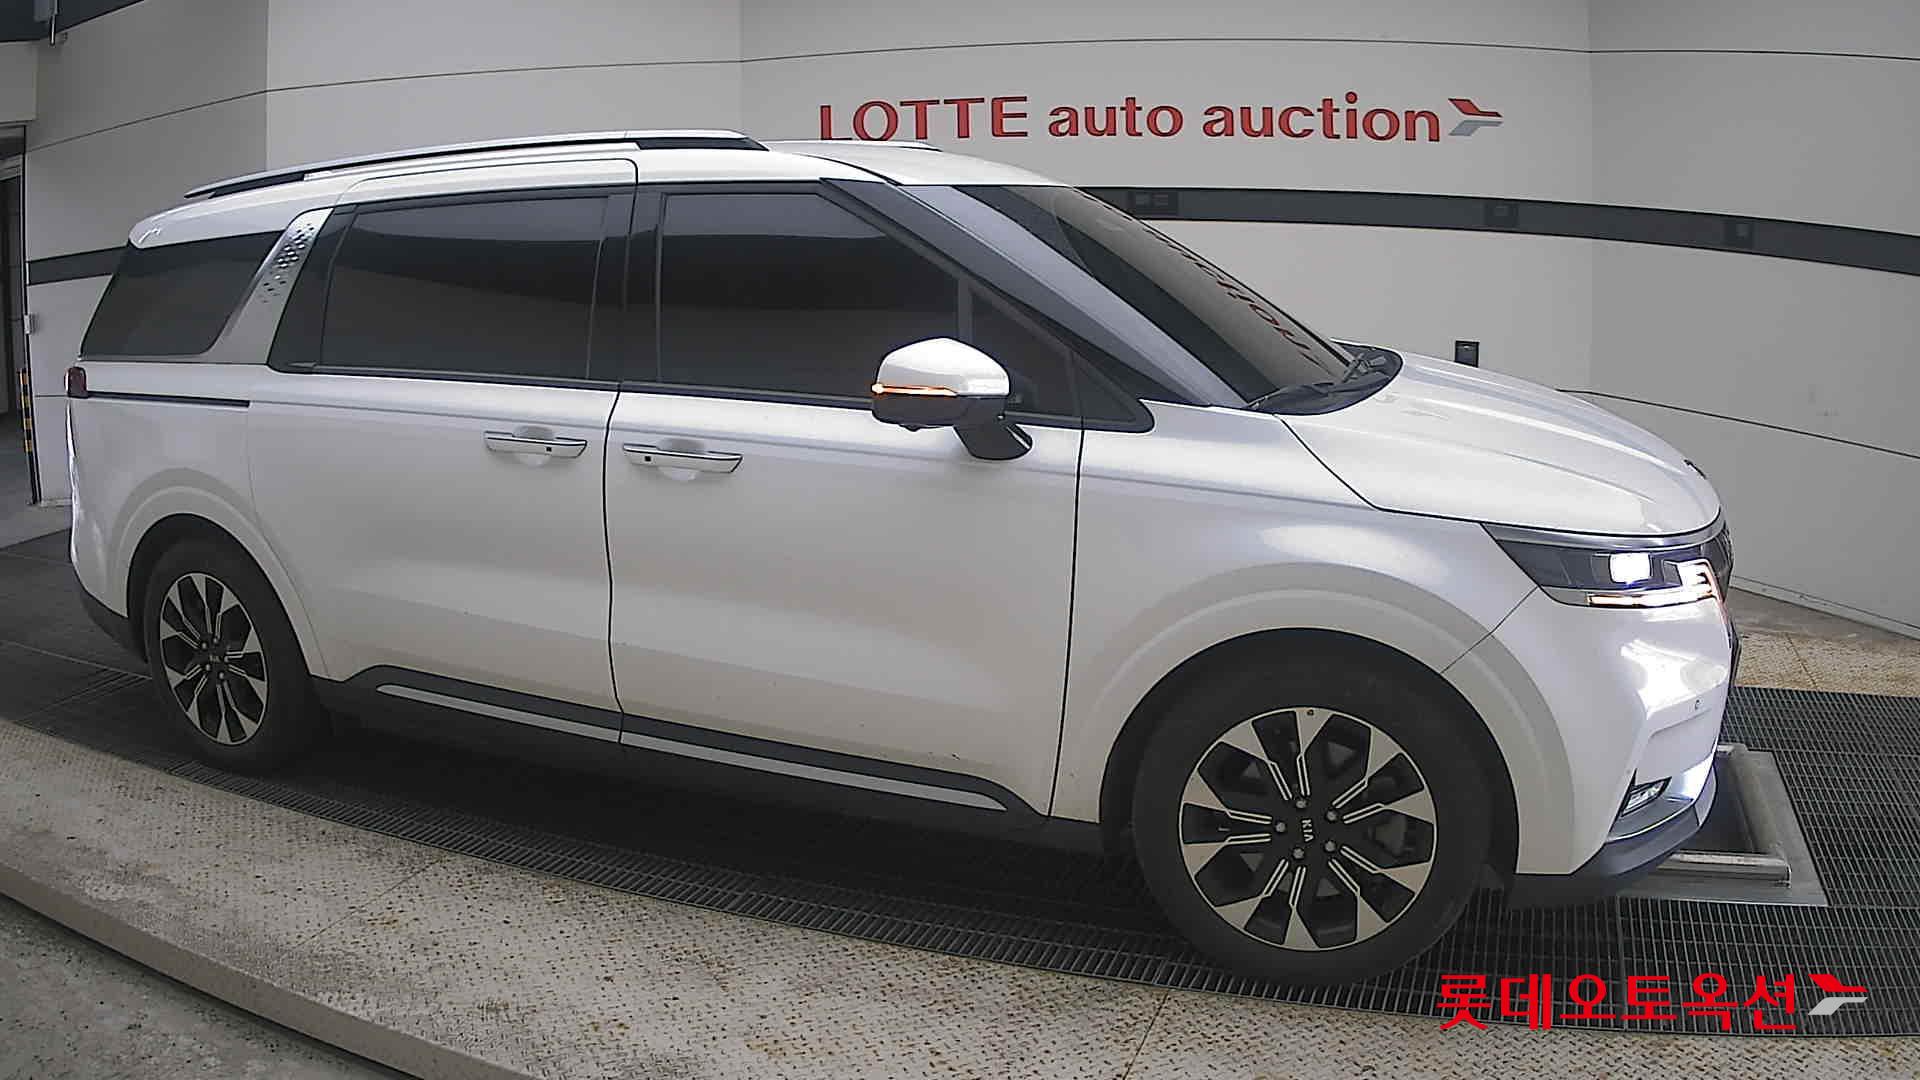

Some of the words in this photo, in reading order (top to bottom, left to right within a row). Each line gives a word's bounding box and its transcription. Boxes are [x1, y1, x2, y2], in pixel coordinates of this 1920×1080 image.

[819, 96, 1027, 141] LOTTE
[1048, 97, 1184, 137] auto
[1203, 91, 1441, 142] auction
[1301, 818, 1314, 842] KIA
